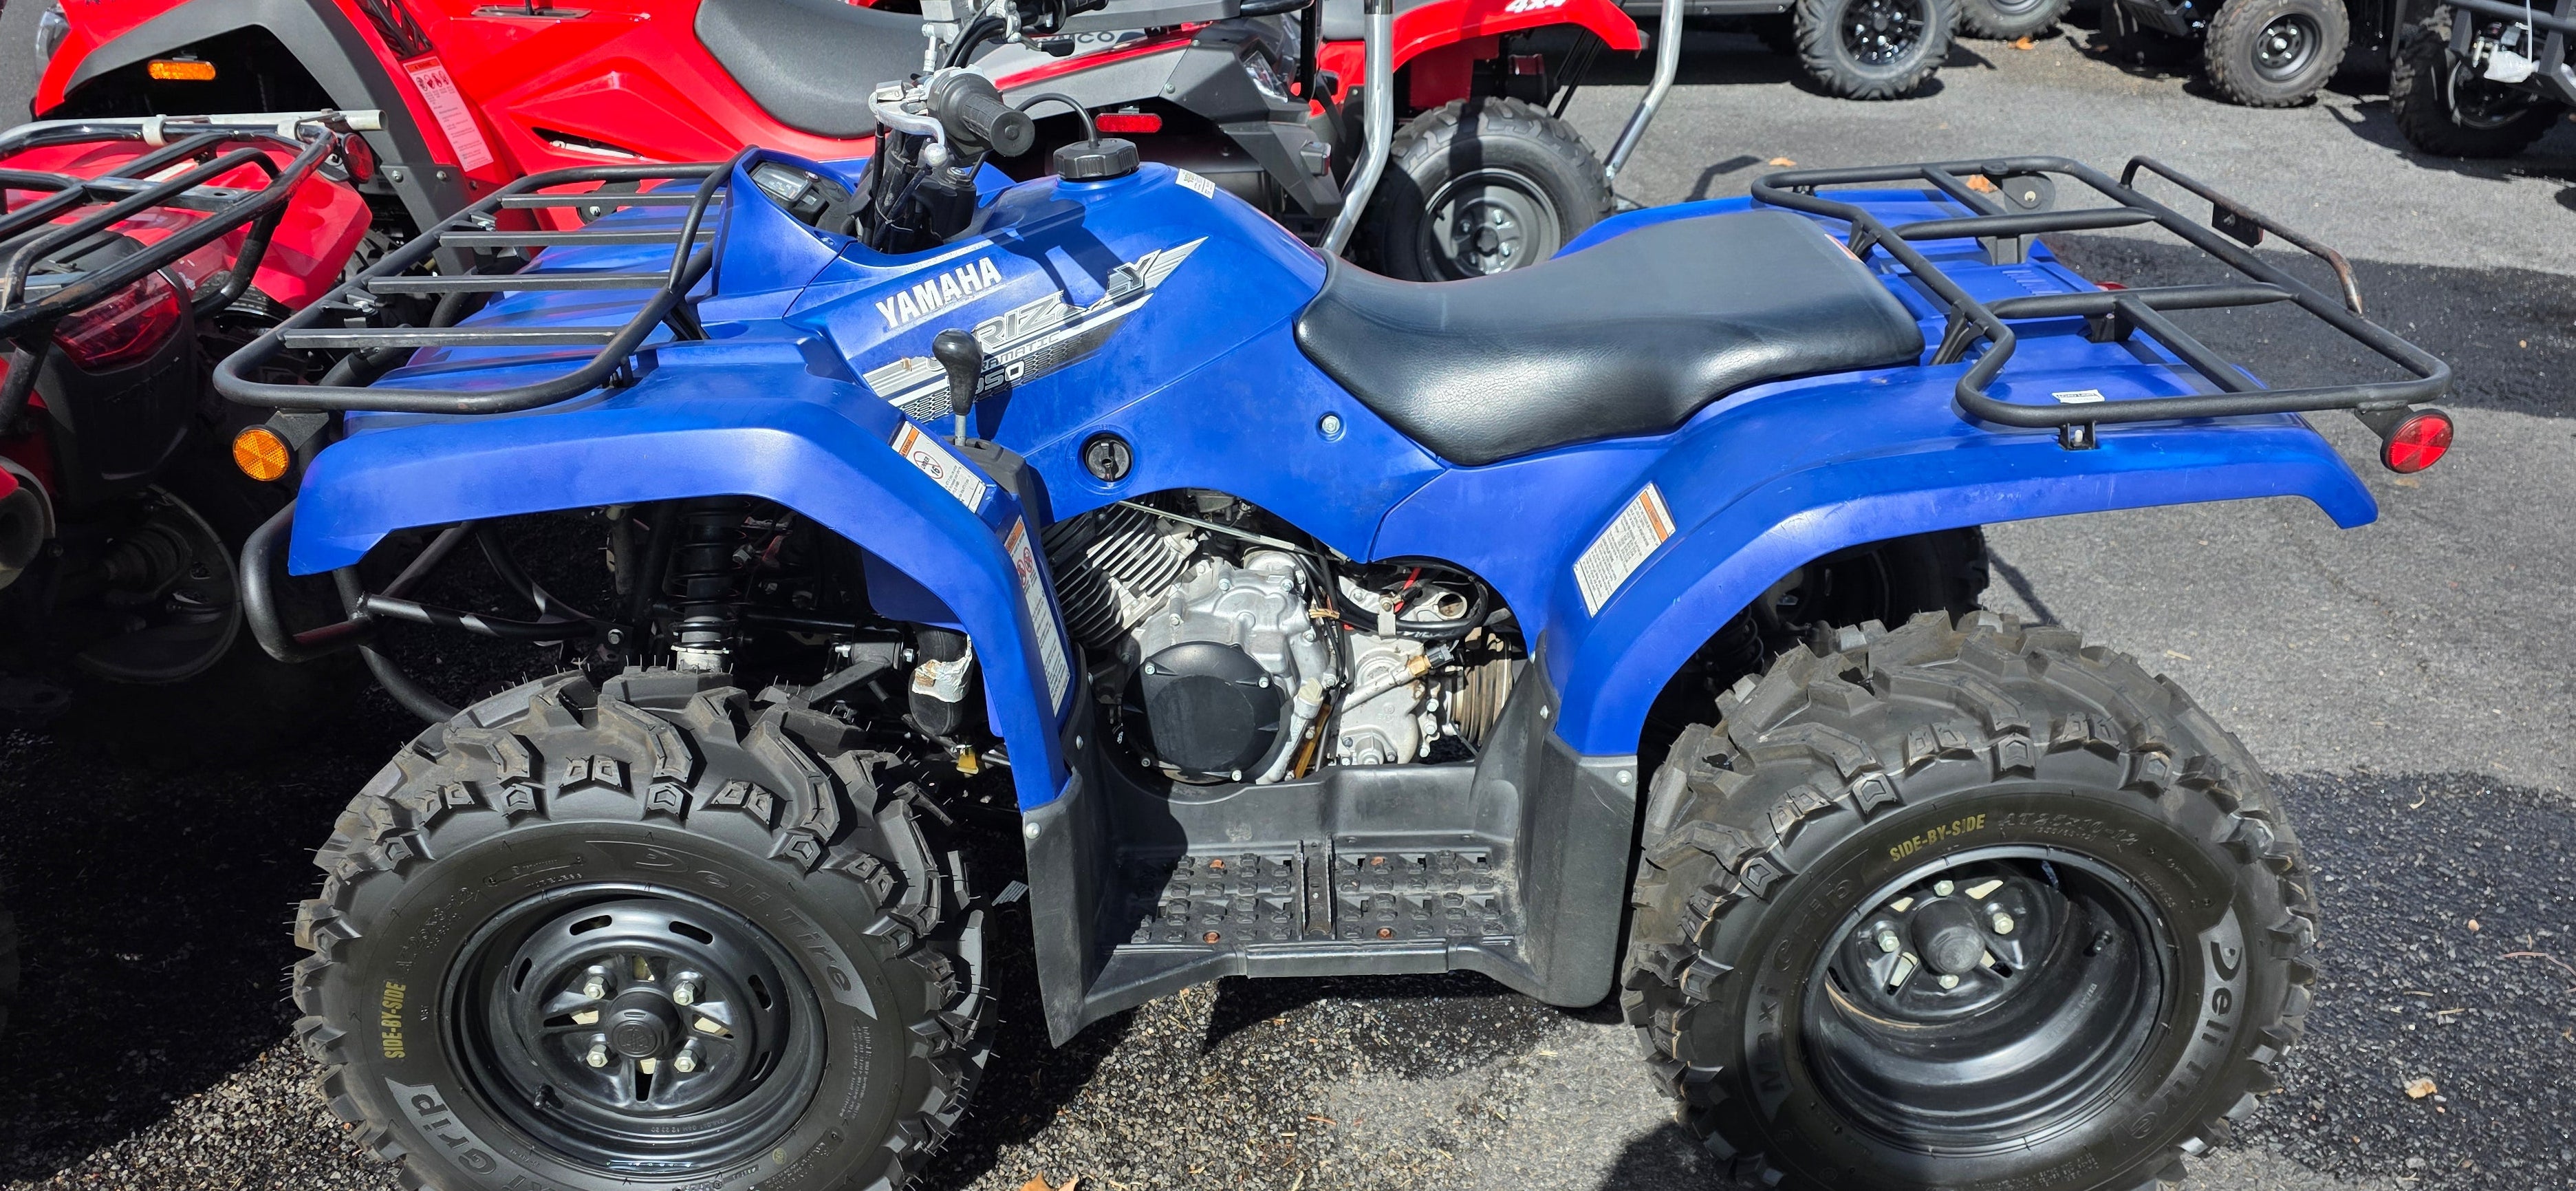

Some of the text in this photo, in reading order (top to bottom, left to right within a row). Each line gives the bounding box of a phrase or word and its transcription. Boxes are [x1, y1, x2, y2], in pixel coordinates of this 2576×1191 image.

[875, 257, 1002, 329] YAMAHA
[930, 466, 941, 477] 16
[1890, 813, 1986, 862] SIDE-BY-SIDE
[381, 981, 407, 1059] SIDE-BY-SIDE
[2202, 941, 2243, 1047] Deli
[1756, 983, 1784, 1093] Maxi
[411, 1093, 497, 1175] Grip
